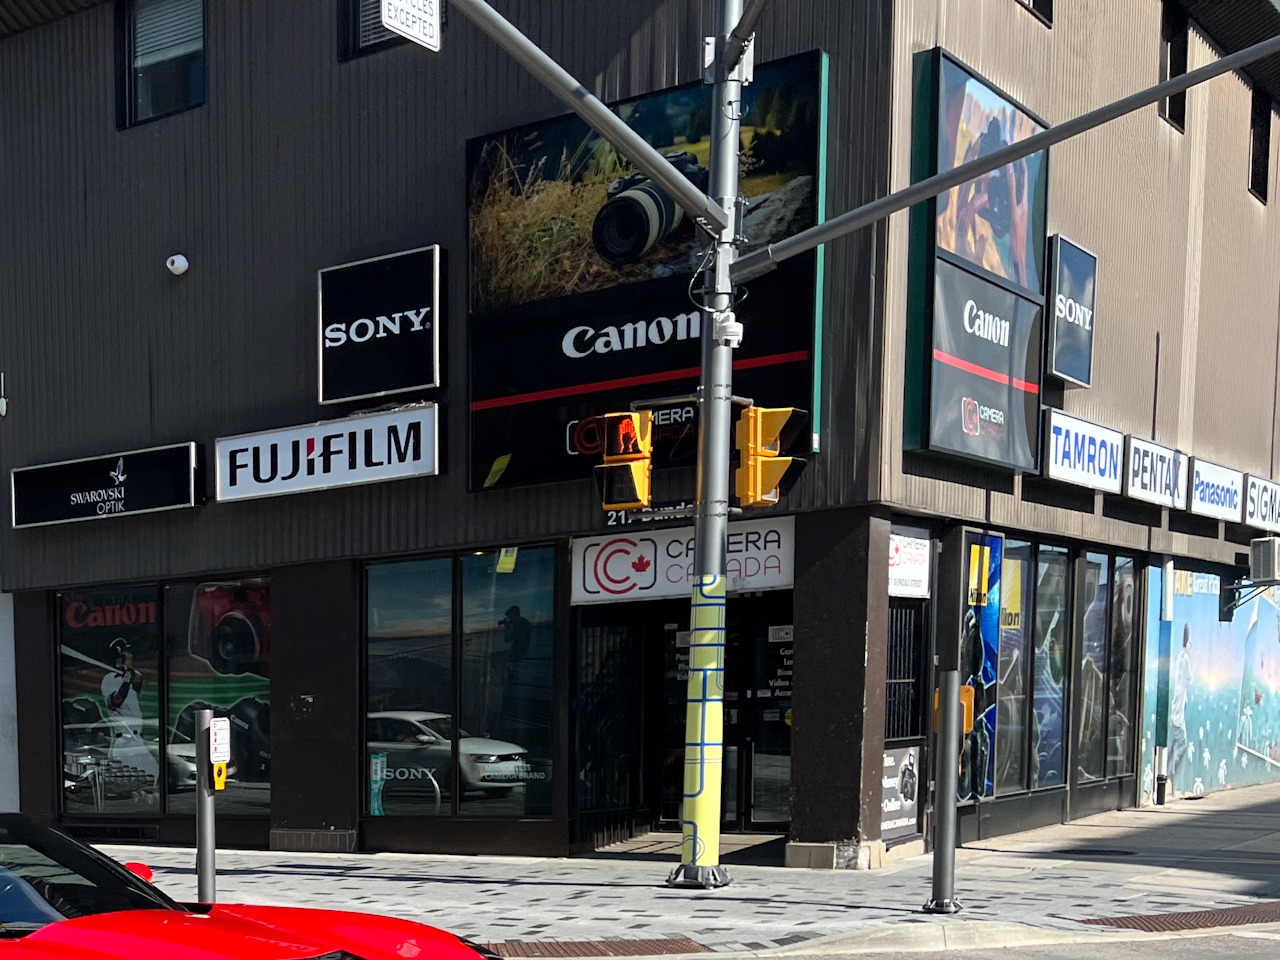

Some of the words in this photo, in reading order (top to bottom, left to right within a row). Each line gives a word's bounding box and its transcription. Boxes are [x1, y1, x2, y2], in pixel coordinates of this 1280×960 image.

[387, 2, 435, 40] EXCEPTED
[399, 0, 434, 18] CLES
[324, 307, 430, 348] SONY
[963, 299, 1010, 348] Canon
[1055, 293, 1093, 332] SONY
[561, 310, 702, 359] Canon
[980, 404, 1005, 425] CAMERA
[227, 420, 423, 487] FUJIFILM
[1052, 425, 1119, 480] TAMRON
[1131, 446, 1181, 500] PENTAX
[1193, 470, 1239, 510] Panasonic
[70, 486, 126, 506] SWAROVSKI
[96, 499, 126, 515] OPTIK
[665, 529, 782, 559] CERA
[665, 554, 782, 584] CADA
[65, 601, 157, 628] Canon
[384, 767, 437, 780] SONY
[518, 771, 546, 780] BRAND
